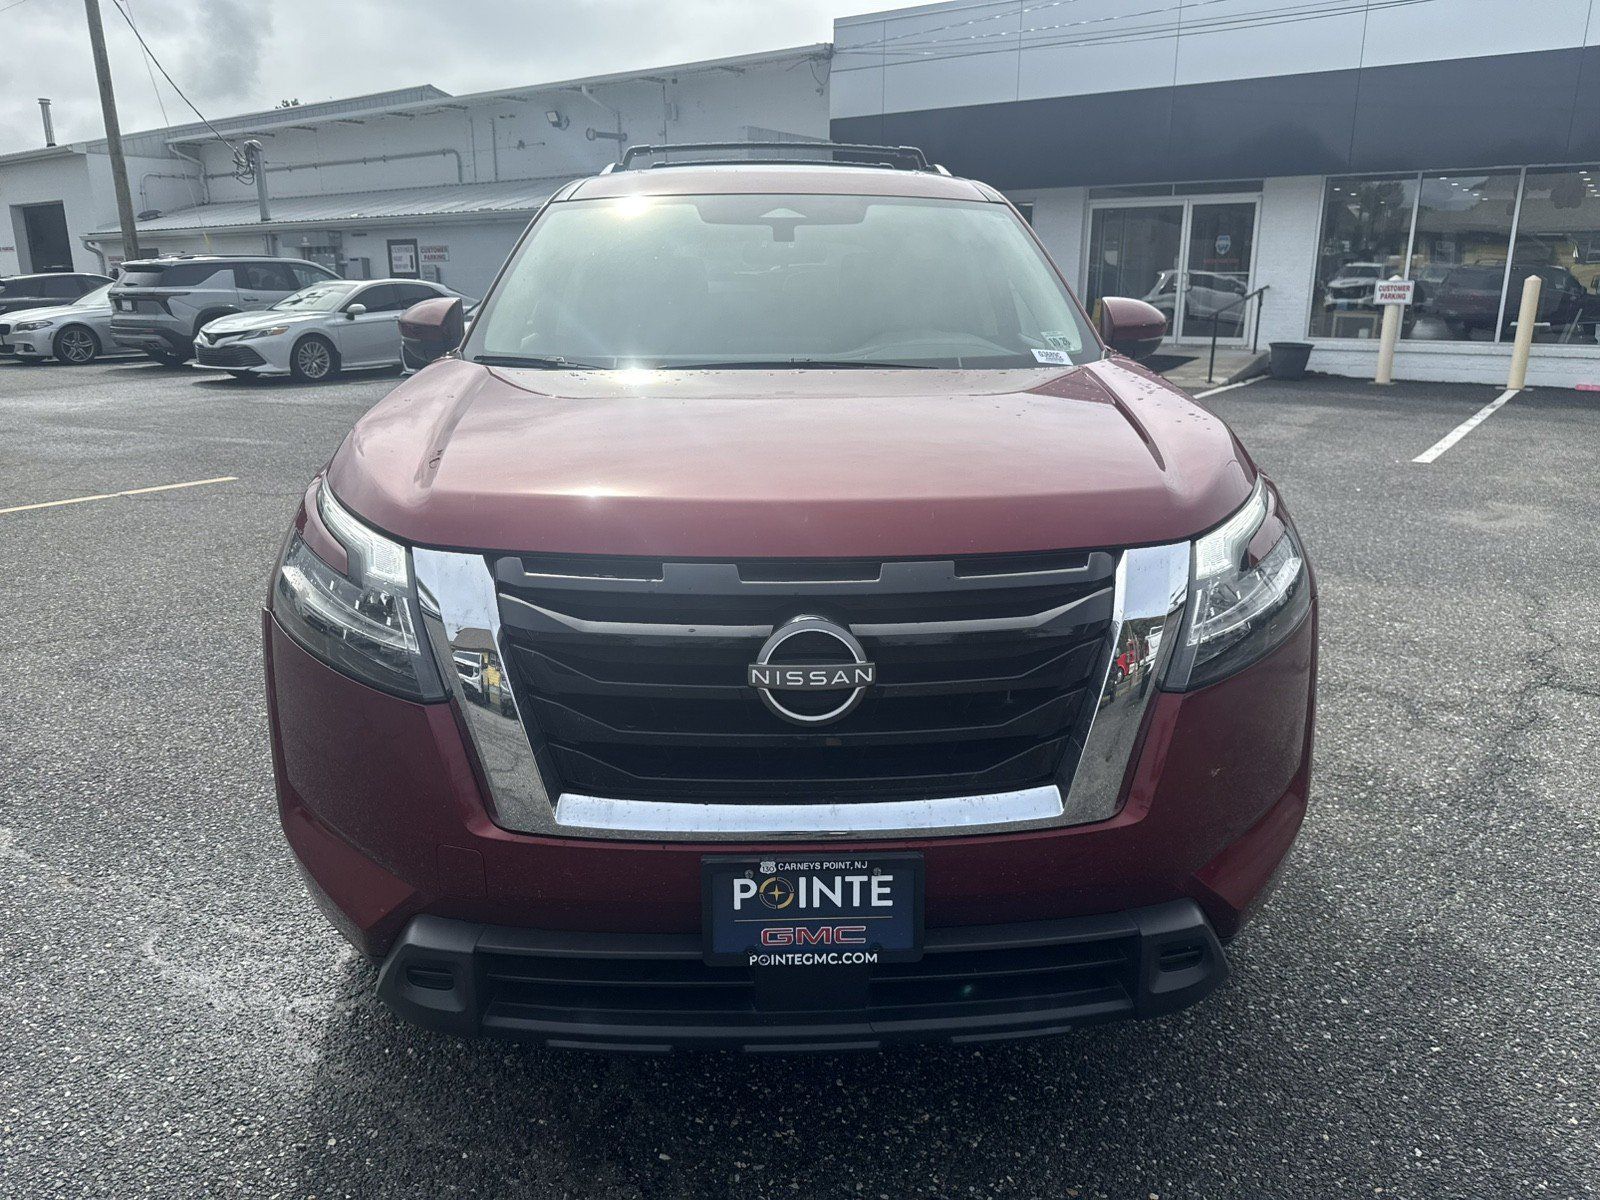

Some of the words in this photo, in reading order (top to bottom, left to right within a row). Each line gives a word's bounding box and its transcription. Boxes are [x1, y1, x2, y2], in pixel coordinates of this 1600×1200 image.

[751, 667, 873, 686] NISSAN
[778, 862, 821, 871] CARNEYS
[823, 861, 853, 870] POINT,
[854, 861, 868, 869] NJ
[733, 874, 894, 910] POINTE
[761, 926, 867, 946] GMC
[749, 952, 878, 966] POINTEGMC.COM
